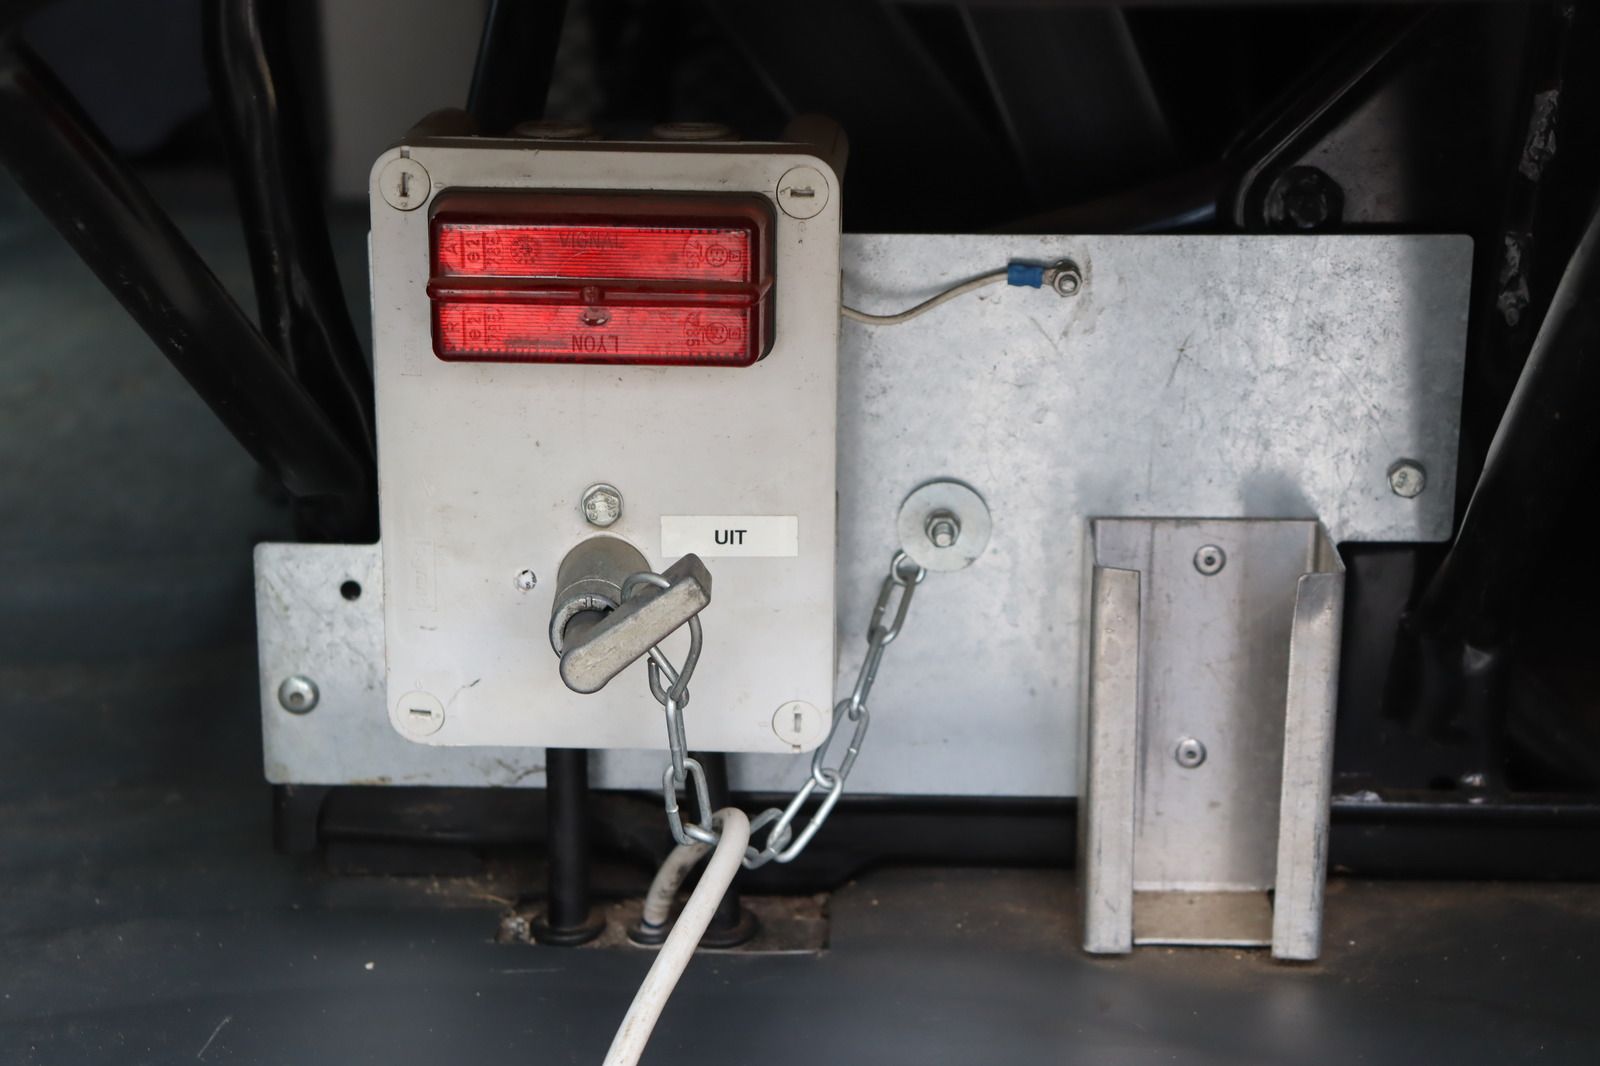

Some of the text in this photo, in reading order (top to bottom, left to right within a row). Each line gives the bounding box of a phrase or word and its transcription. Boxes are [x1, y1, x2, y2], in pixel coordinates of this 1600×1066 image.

[559, 231, 625, 249] VIGNAL
[571, 335, 619, 353] LYON
[714, 529, 748, 545] UIT
